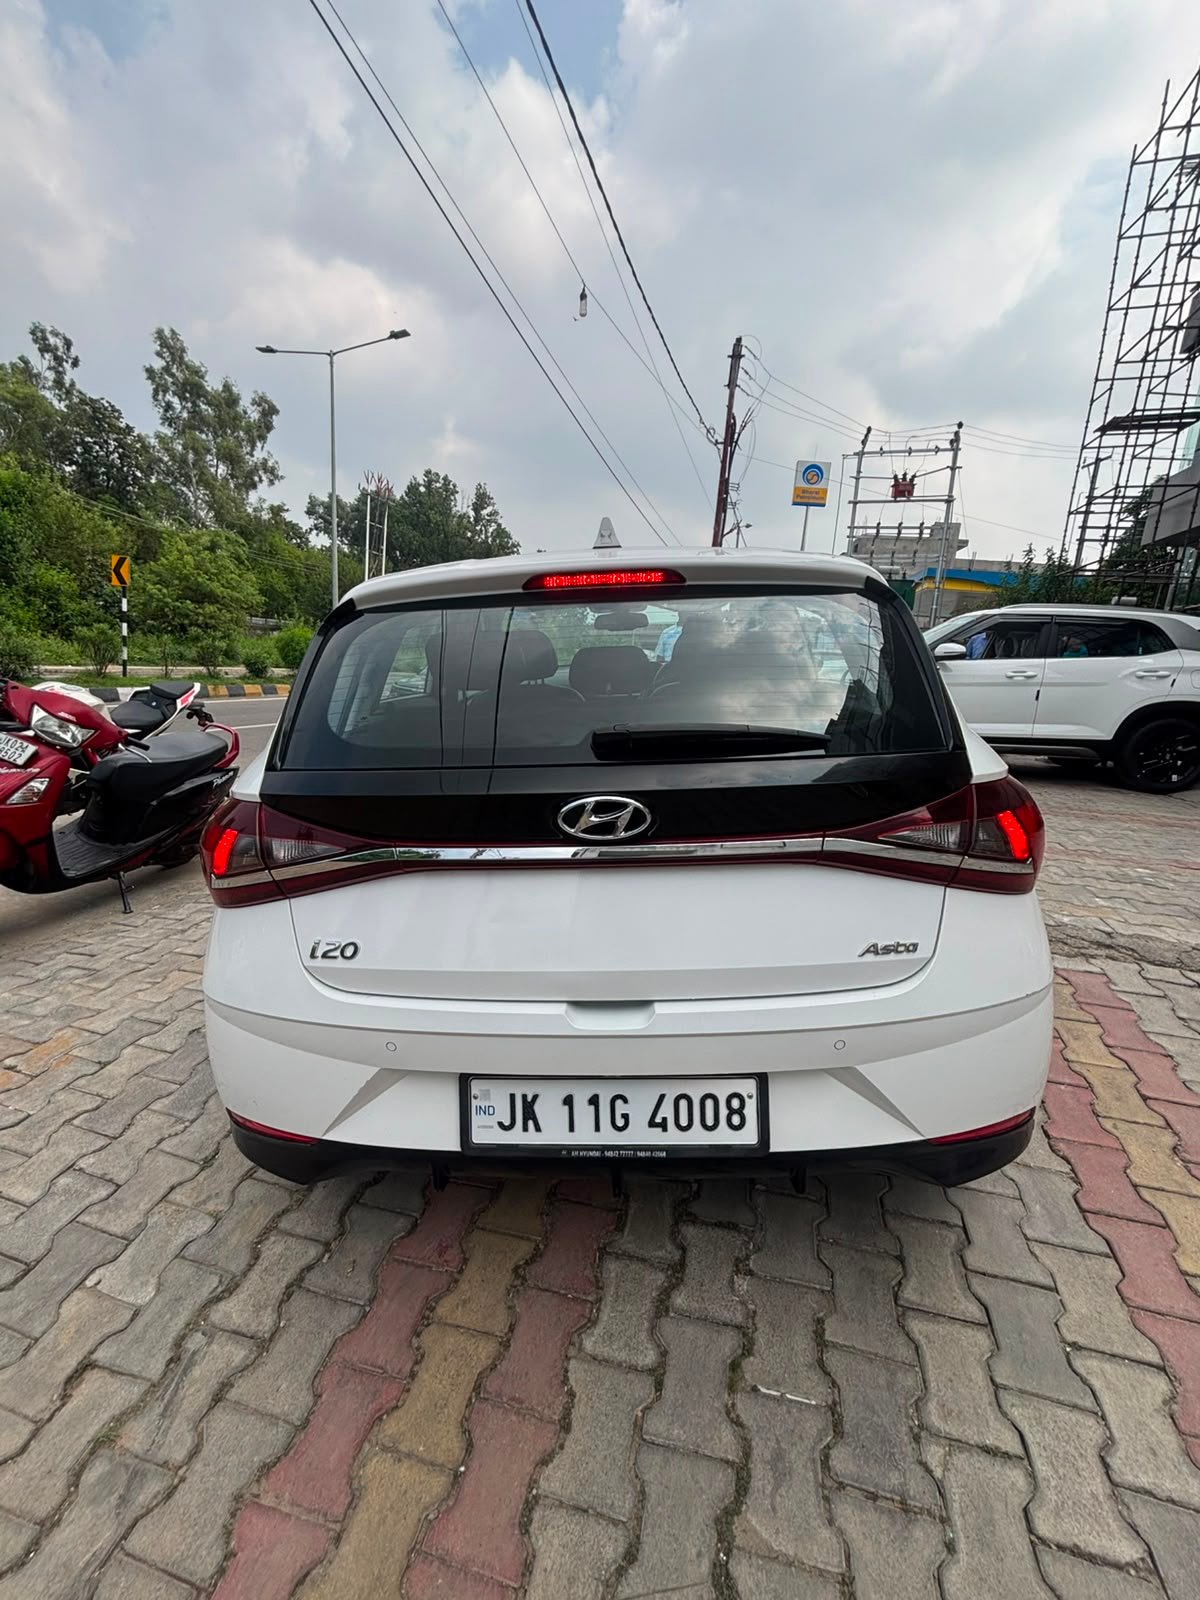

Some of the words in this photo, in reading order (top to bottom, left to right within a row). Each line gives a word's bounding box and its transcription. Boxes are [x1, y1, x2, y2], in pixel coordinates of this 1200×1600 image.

[309, 939, 360, 960] i20
[857, 941, 919, 957] Asta
[475, 1104, 496, 1116] IND
[497, 1092, 542, 1133] JK
[562, 1092, 630, 1133] 11G
[647, 1091, 746, 1133] 4008
